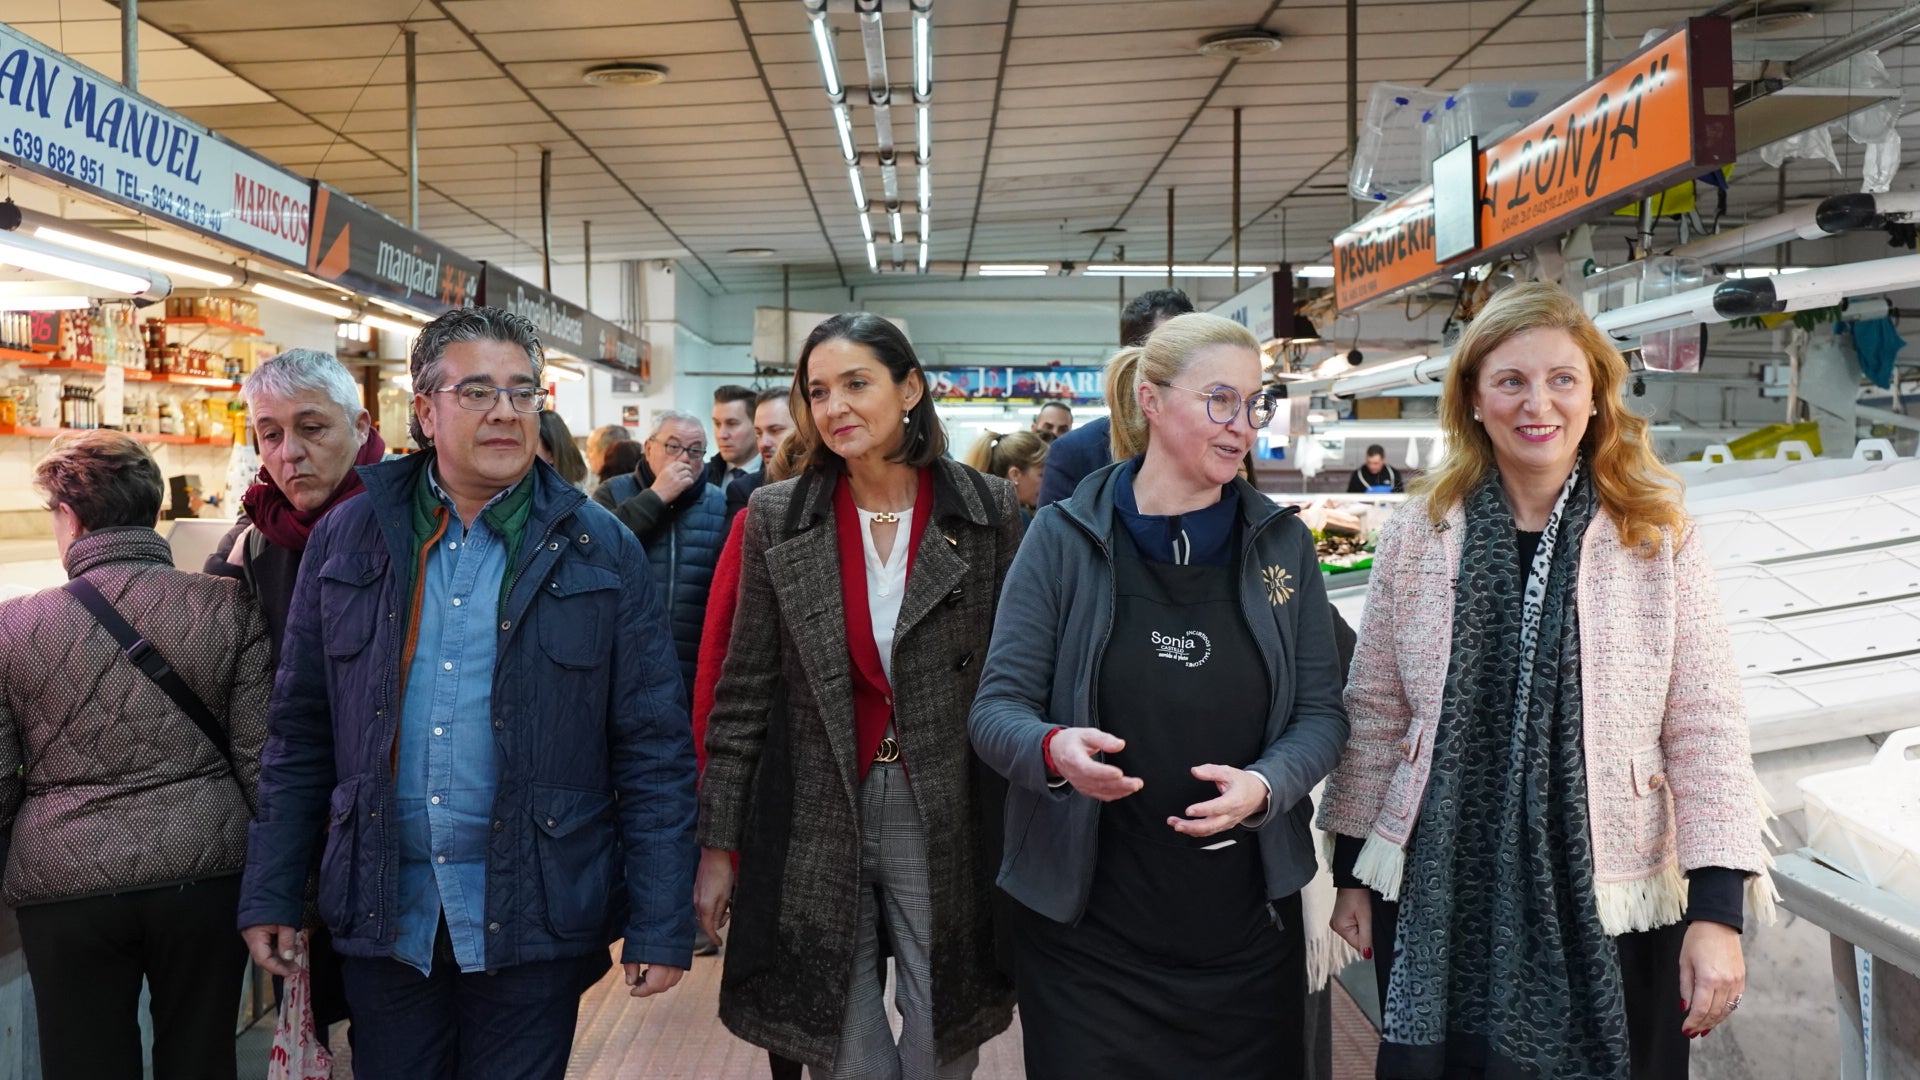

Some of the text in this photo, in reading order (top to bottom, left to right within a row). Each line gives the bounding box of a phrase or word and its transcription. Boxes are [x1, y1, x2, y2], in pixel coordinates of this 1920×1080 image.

[64, 75, 202, 186] MANUEL
[13, 127, 43, 163] 639
[47, 142, 75, 176] 682
[79, 154, 105, 187] 951
[152, 184, 173, 211] 964
[232, 172, 309, 247] MARISCOS
[376, 240, 441, 298] manjaral
[1151, 631, 1195, 648] Sonia
